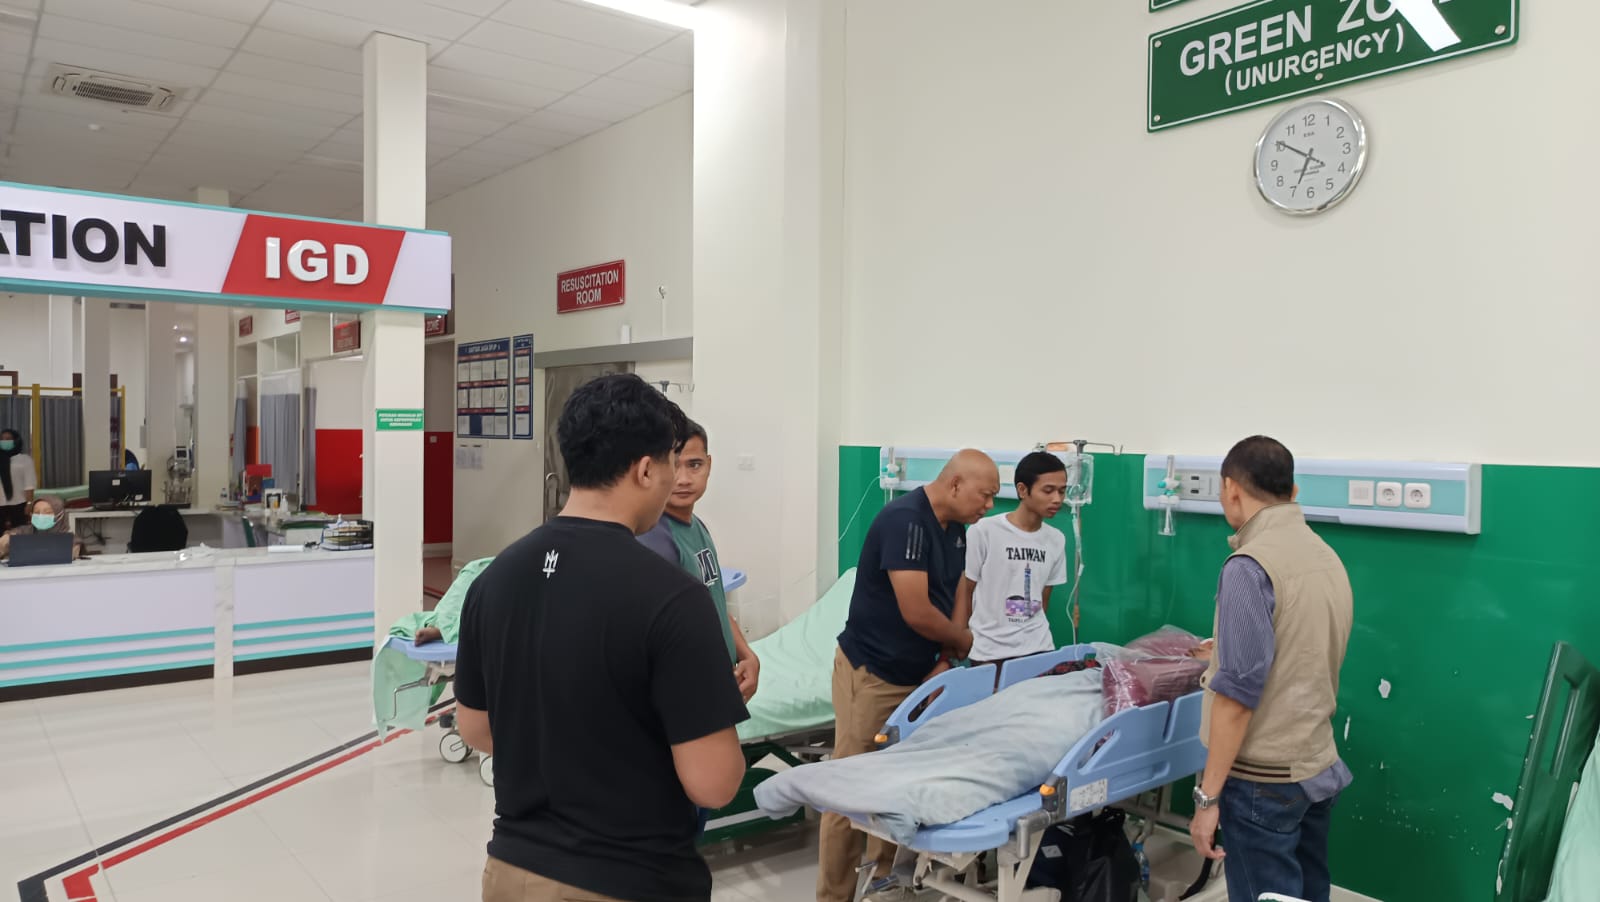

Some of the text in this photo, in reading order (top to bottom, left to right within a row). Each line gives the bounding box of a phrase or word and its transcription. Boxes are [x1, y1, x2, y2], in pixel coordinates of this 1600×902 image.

[1180, 4, 1312, 77] GREEN
[1302, 113, 1316, 127] 12
[1325, 114, 1330, 127] 1
[1286, 124, 1296, 137] 11
[1336, 126, 1345, 139] 2
[1342, 142, 1351, 155] 3
[1270, 159, 1279, 172] 9
[1337, 161, 1345, 174] 4
[1276, 175, 1284, 187] 8
[1325, 178, 1334, 190] 5
[1289, 185, 1297, 198] 7
[1306, 186, 1315, 199] 6
[265, 236, 369, 285] IGD
[561, 269, 619, 293] RESUSCITATION
[576, 288, 602, 305] ROOM
[1006, 547, 1046, 563] TAIWAN
